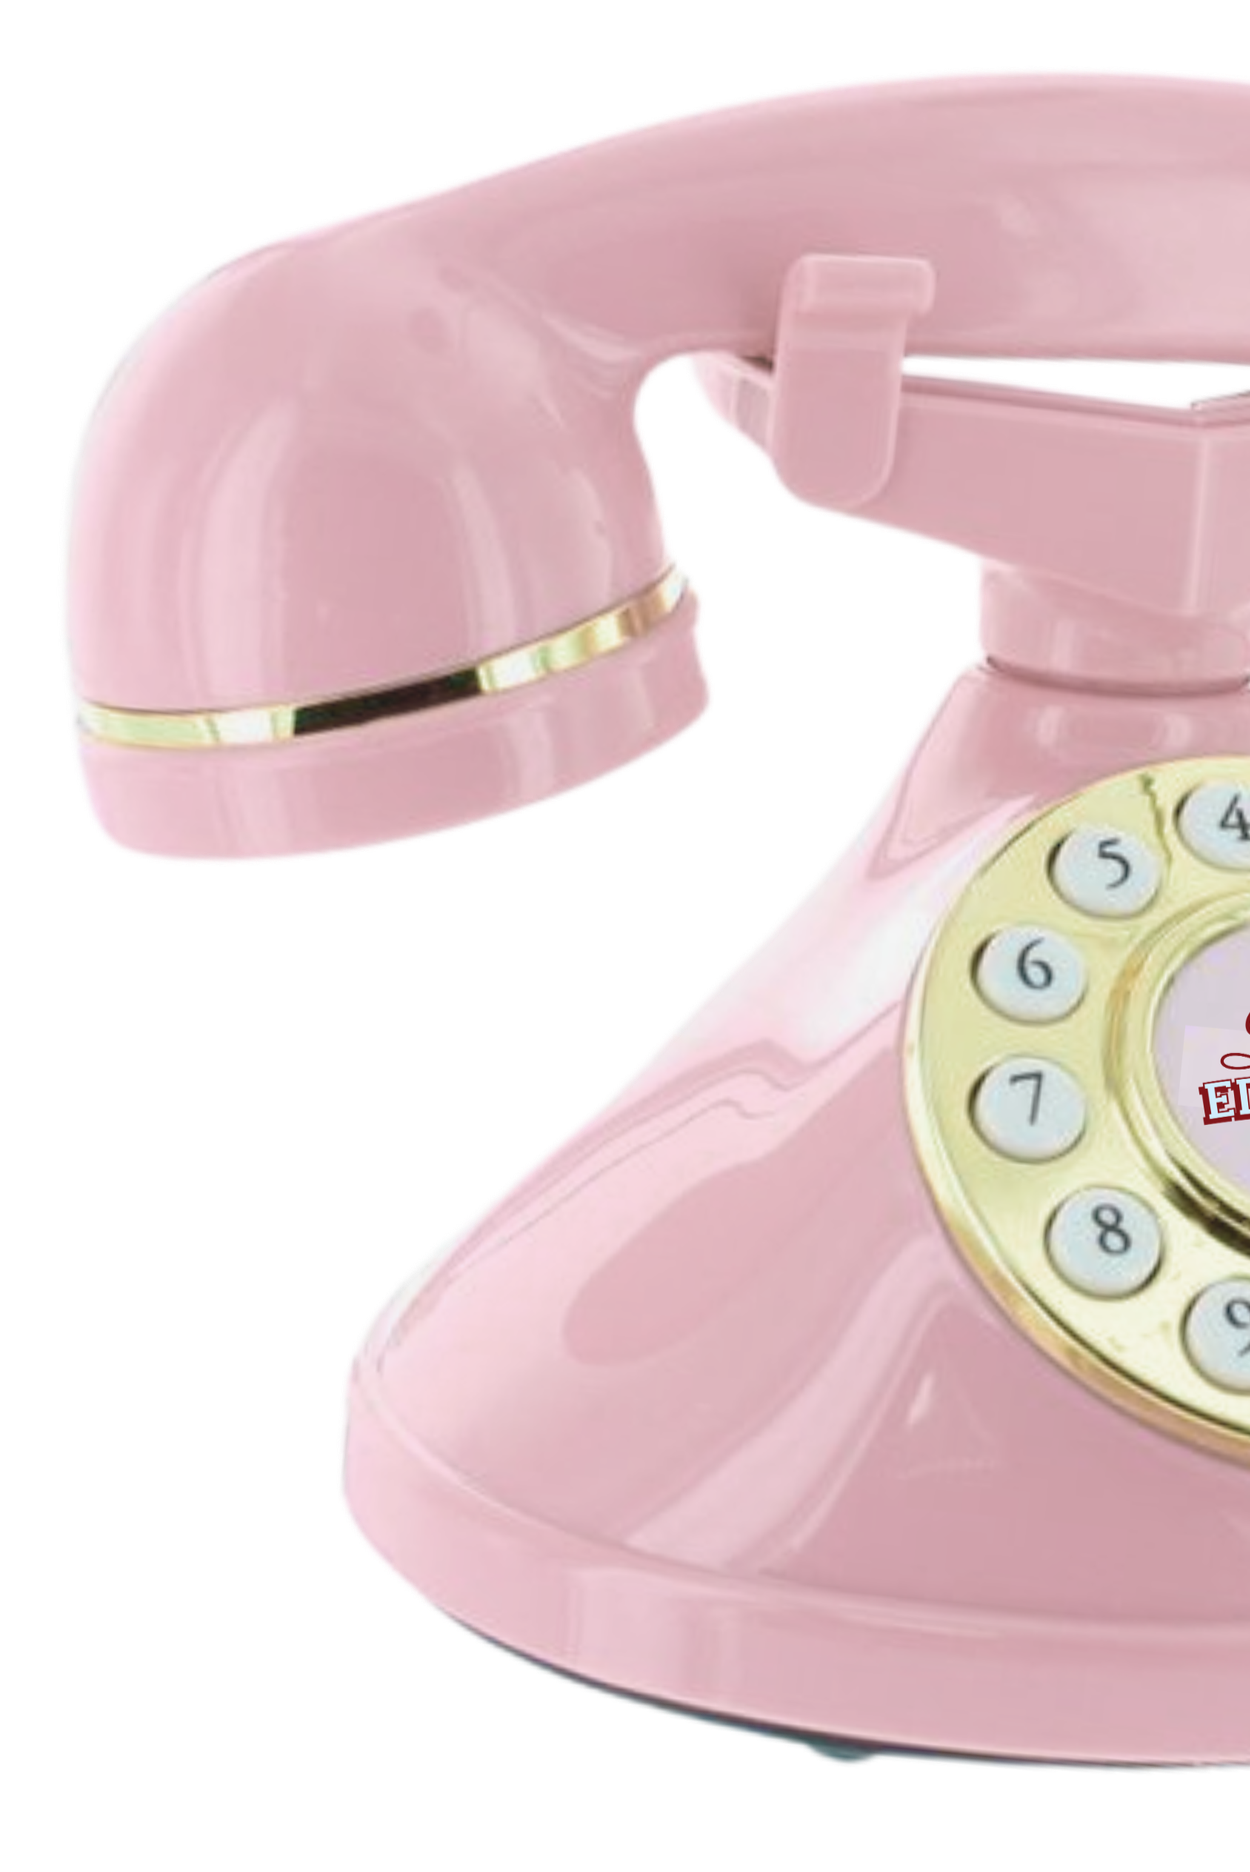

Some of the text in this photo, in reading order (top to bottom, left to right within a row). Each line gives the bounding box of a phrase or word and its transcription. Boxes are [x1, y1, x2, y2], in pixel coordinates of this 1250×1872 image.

[1098, 839, 1130, 888] 5
[1017, 940, 1053, 989] 6
[1010, 1072, 1043, 1125] 7
[1092, 1205, 1131, 1254] 8
